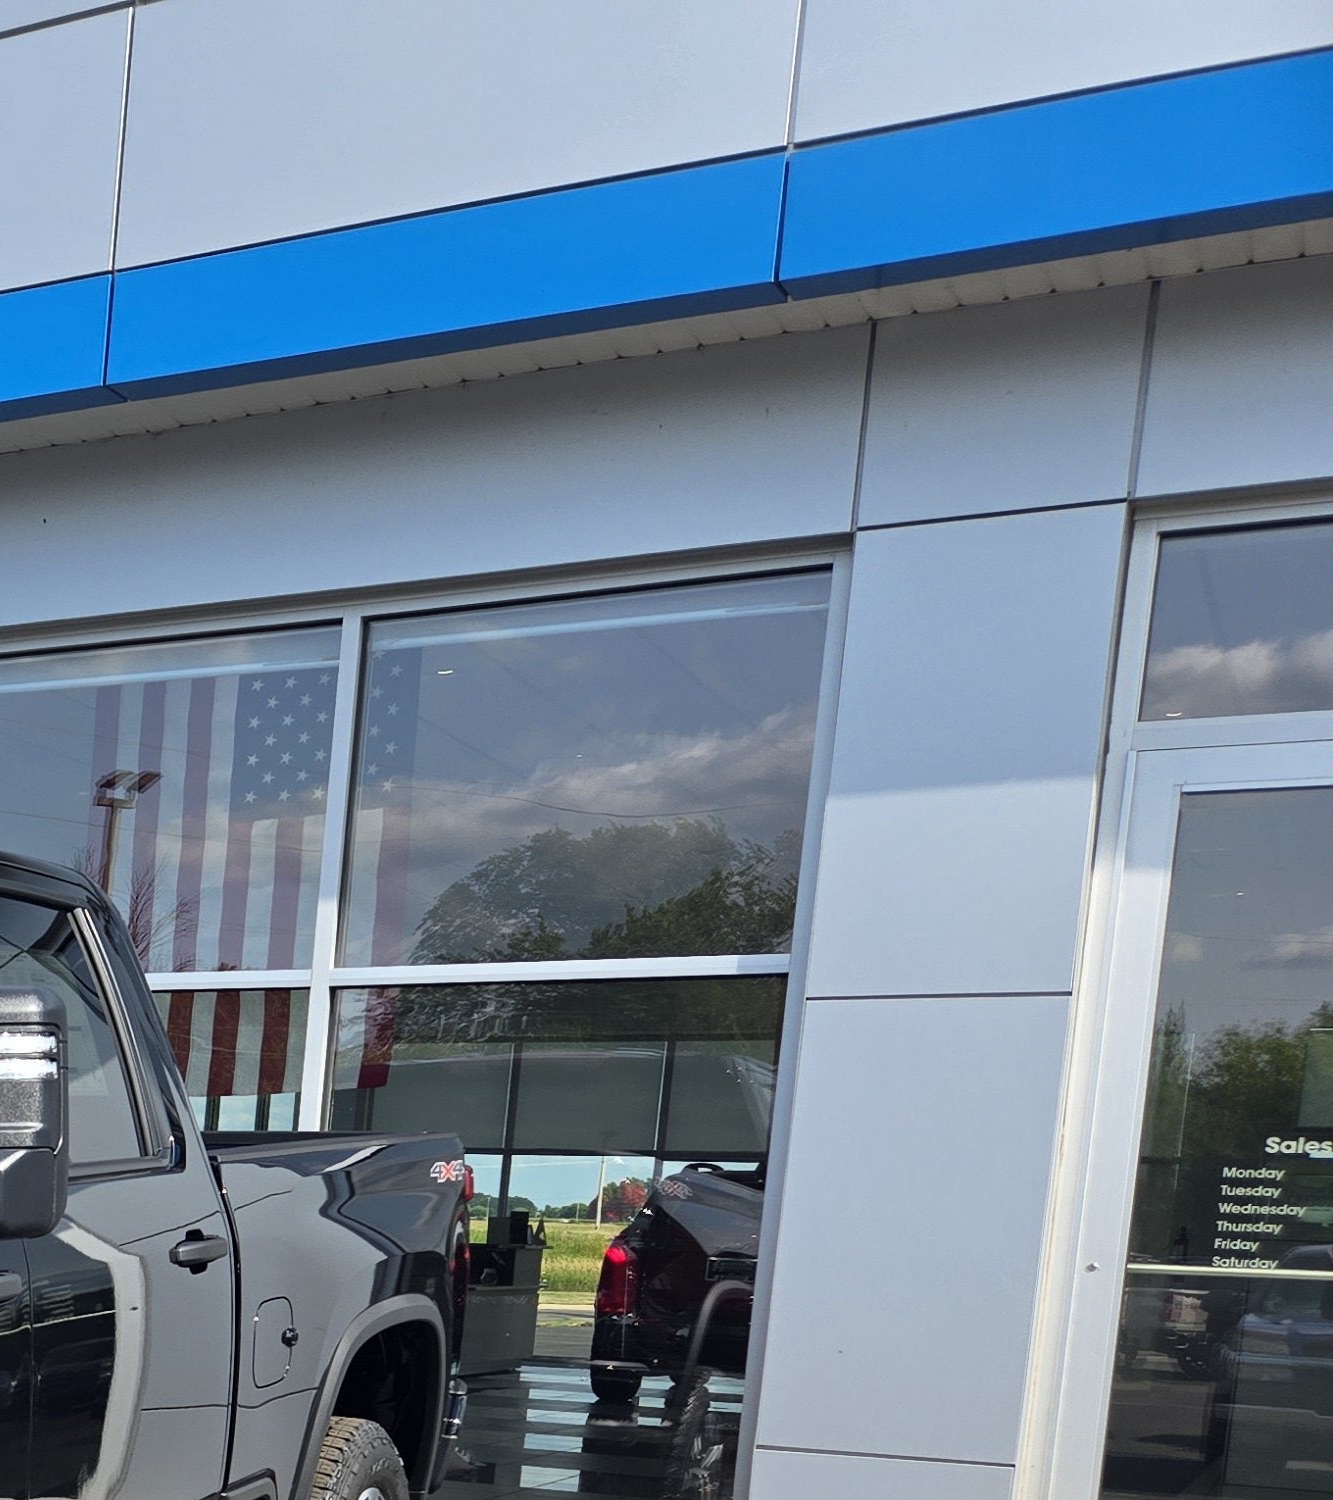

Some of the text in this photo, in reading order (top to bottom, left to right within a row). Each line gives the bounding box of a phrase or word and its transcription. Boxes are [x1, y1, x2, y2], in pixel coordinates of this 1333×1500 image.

[1264, 1136, 1333, 1154] Sales
[1222, 1166, 1286, 1181] Monday
[1220, 1184, 1282, 1198] Tuesday
[1218, 1202, 1308, 1217] Wednesday
[1215, 1220, 1283, 1235] Thursday
[1213, 1237, 1260, 1252] Friday
[1211, 1255, 1279, 1270] Saturday
